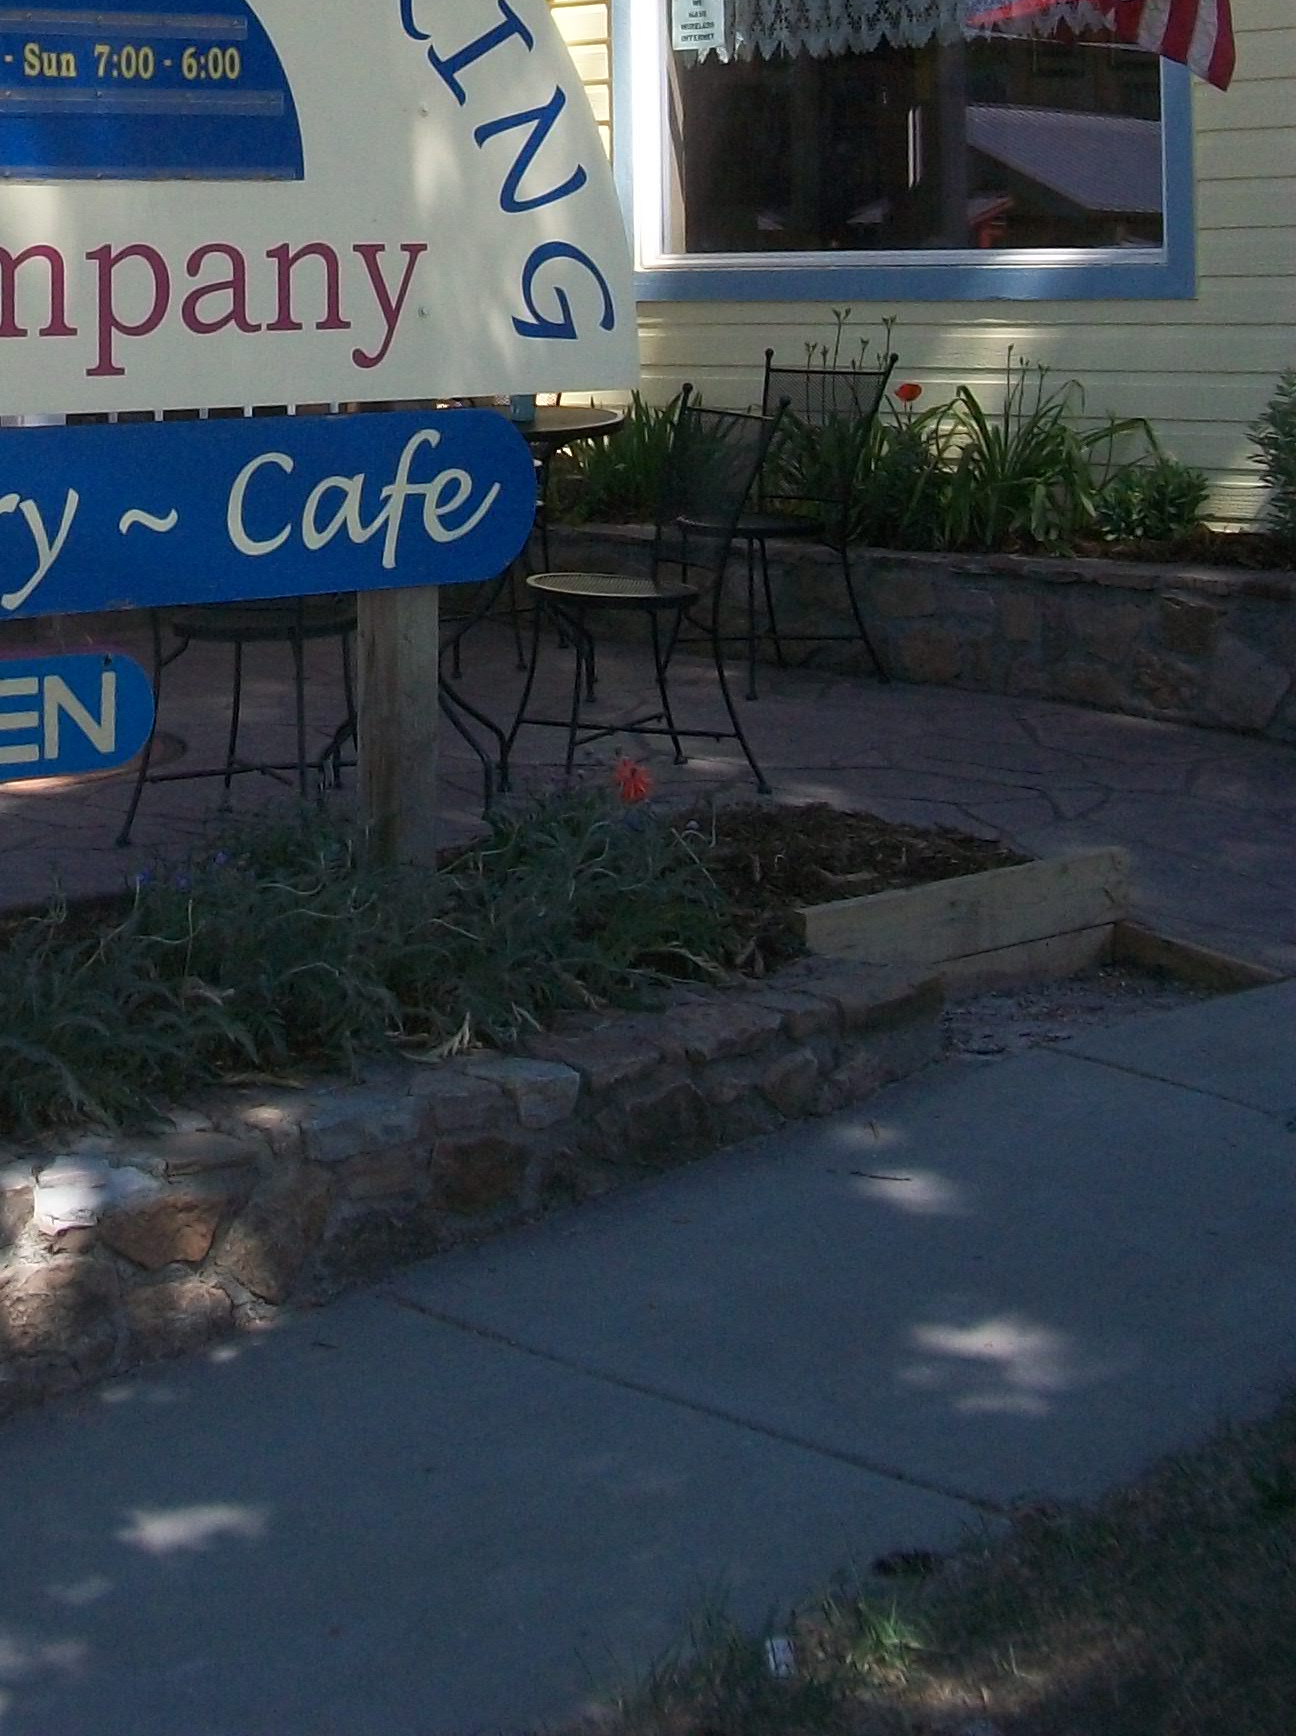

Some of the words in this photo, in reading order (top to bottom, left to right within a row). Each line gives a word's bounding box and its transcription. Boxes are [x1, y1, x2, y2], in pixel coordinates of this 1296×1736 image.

[23, 42, 77, 77] Sun
[94, 44, 155, 79] 7:00
[181, 46, 241, 80] 6:00
[225, 427, 502, 570] Cafe
